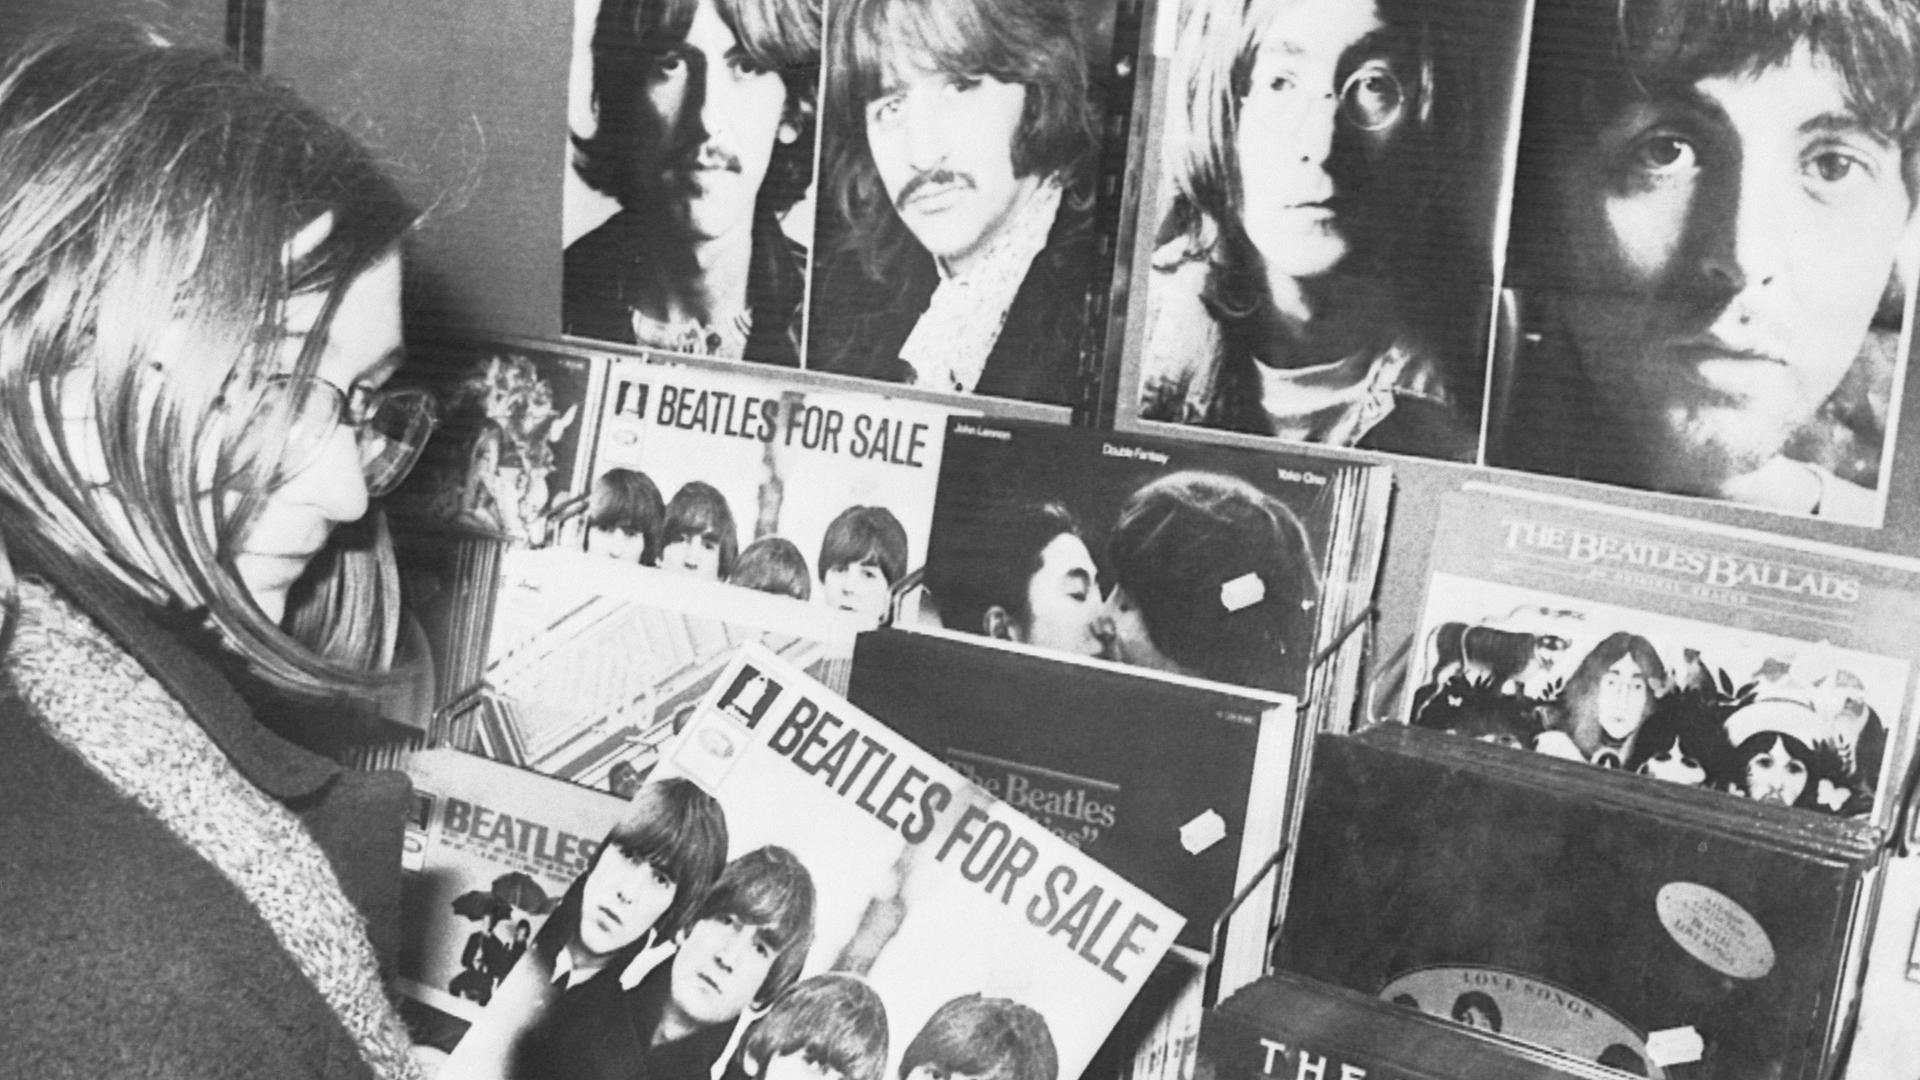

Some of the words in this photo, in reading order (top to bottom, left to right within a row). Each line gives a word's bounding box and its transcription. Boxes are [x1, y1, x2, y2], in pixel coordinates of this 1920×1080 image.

[657, 384, 779, 444] BEATLES
[785, 401, 843, 453] FOR
[850, 414, 929, 468] SALE
[1102, 443, 1134, 459] Double
[1302, 471, 1326, 485] Ono
[1501, 519, 1566, 549] THE
[1567, 530, 1705, 576] BEATLES
[1705, 556, 1860, 603] BALLADS
[443, 797, 602, 871] BEATLES
[1005, 773, 1116, 828] Beatles
[767, 696, 952, 844] BEATLES
[935, 804, 1039, 905] FOR
[1026, 865, 1159, 984] SALE
